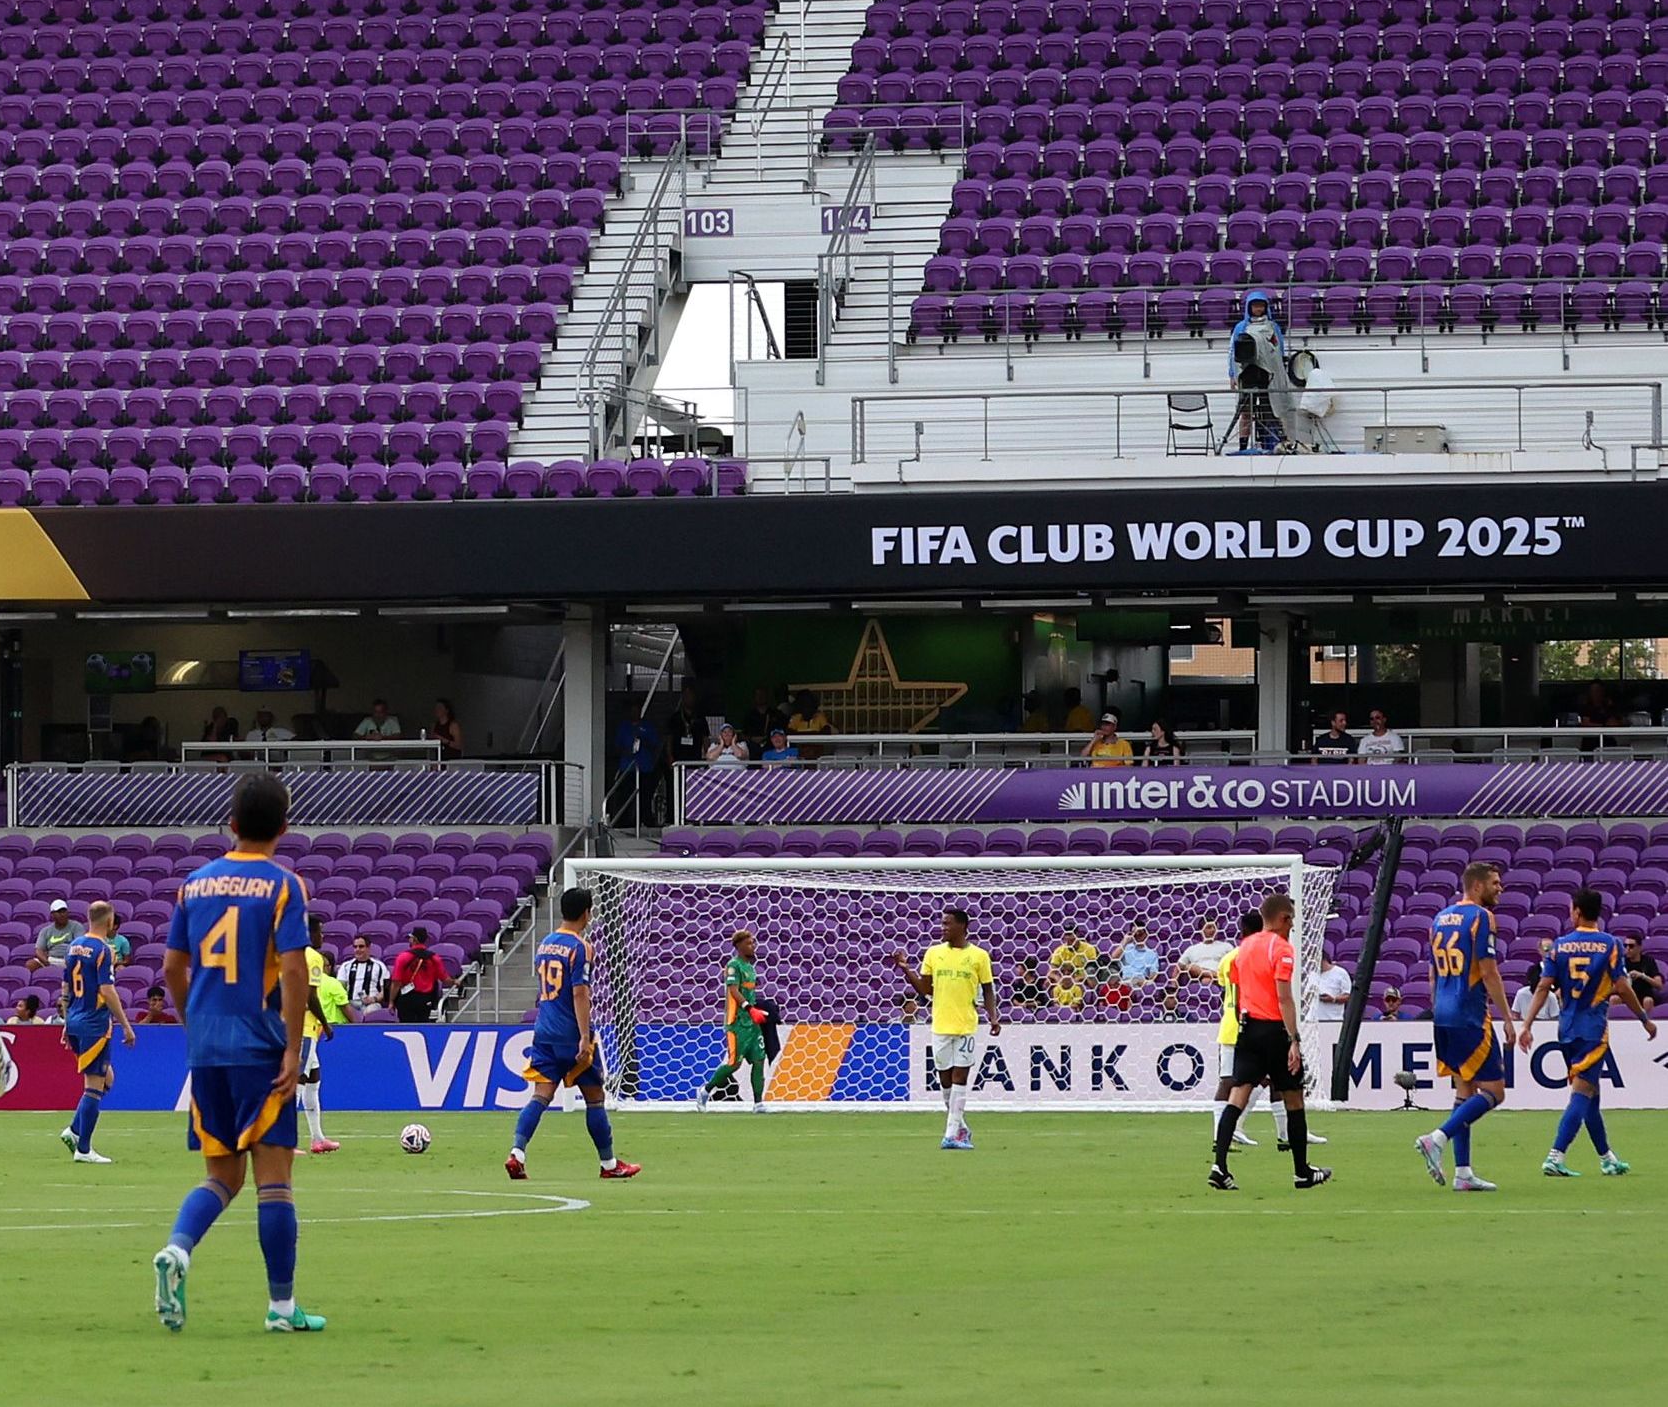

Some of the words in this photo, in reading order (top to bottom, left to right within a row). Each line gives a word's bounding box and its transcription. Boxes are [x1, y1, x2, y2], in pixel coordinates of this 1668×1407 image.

[686, 210, 730, 234] 103
[871, 527, 978, 566] FIFA
[987, 523, 1116, 565] CLUB
[1126, 519, 1311, 562] WORLD
[1323, 518, 1425, 559] CUP
[1269, 779, 1417, 808] STADIUM
[200, 905, 240, 985] 4
[1431, 931, 1464, 978] 66
[72, 959, 84, 998] 6
[538, 959, 563, 1002] 19
[1568, 956, 1591, 999] 5
[958, 1035, 975, 1054] 20
[383, 1030, 566, 1109] VIS
